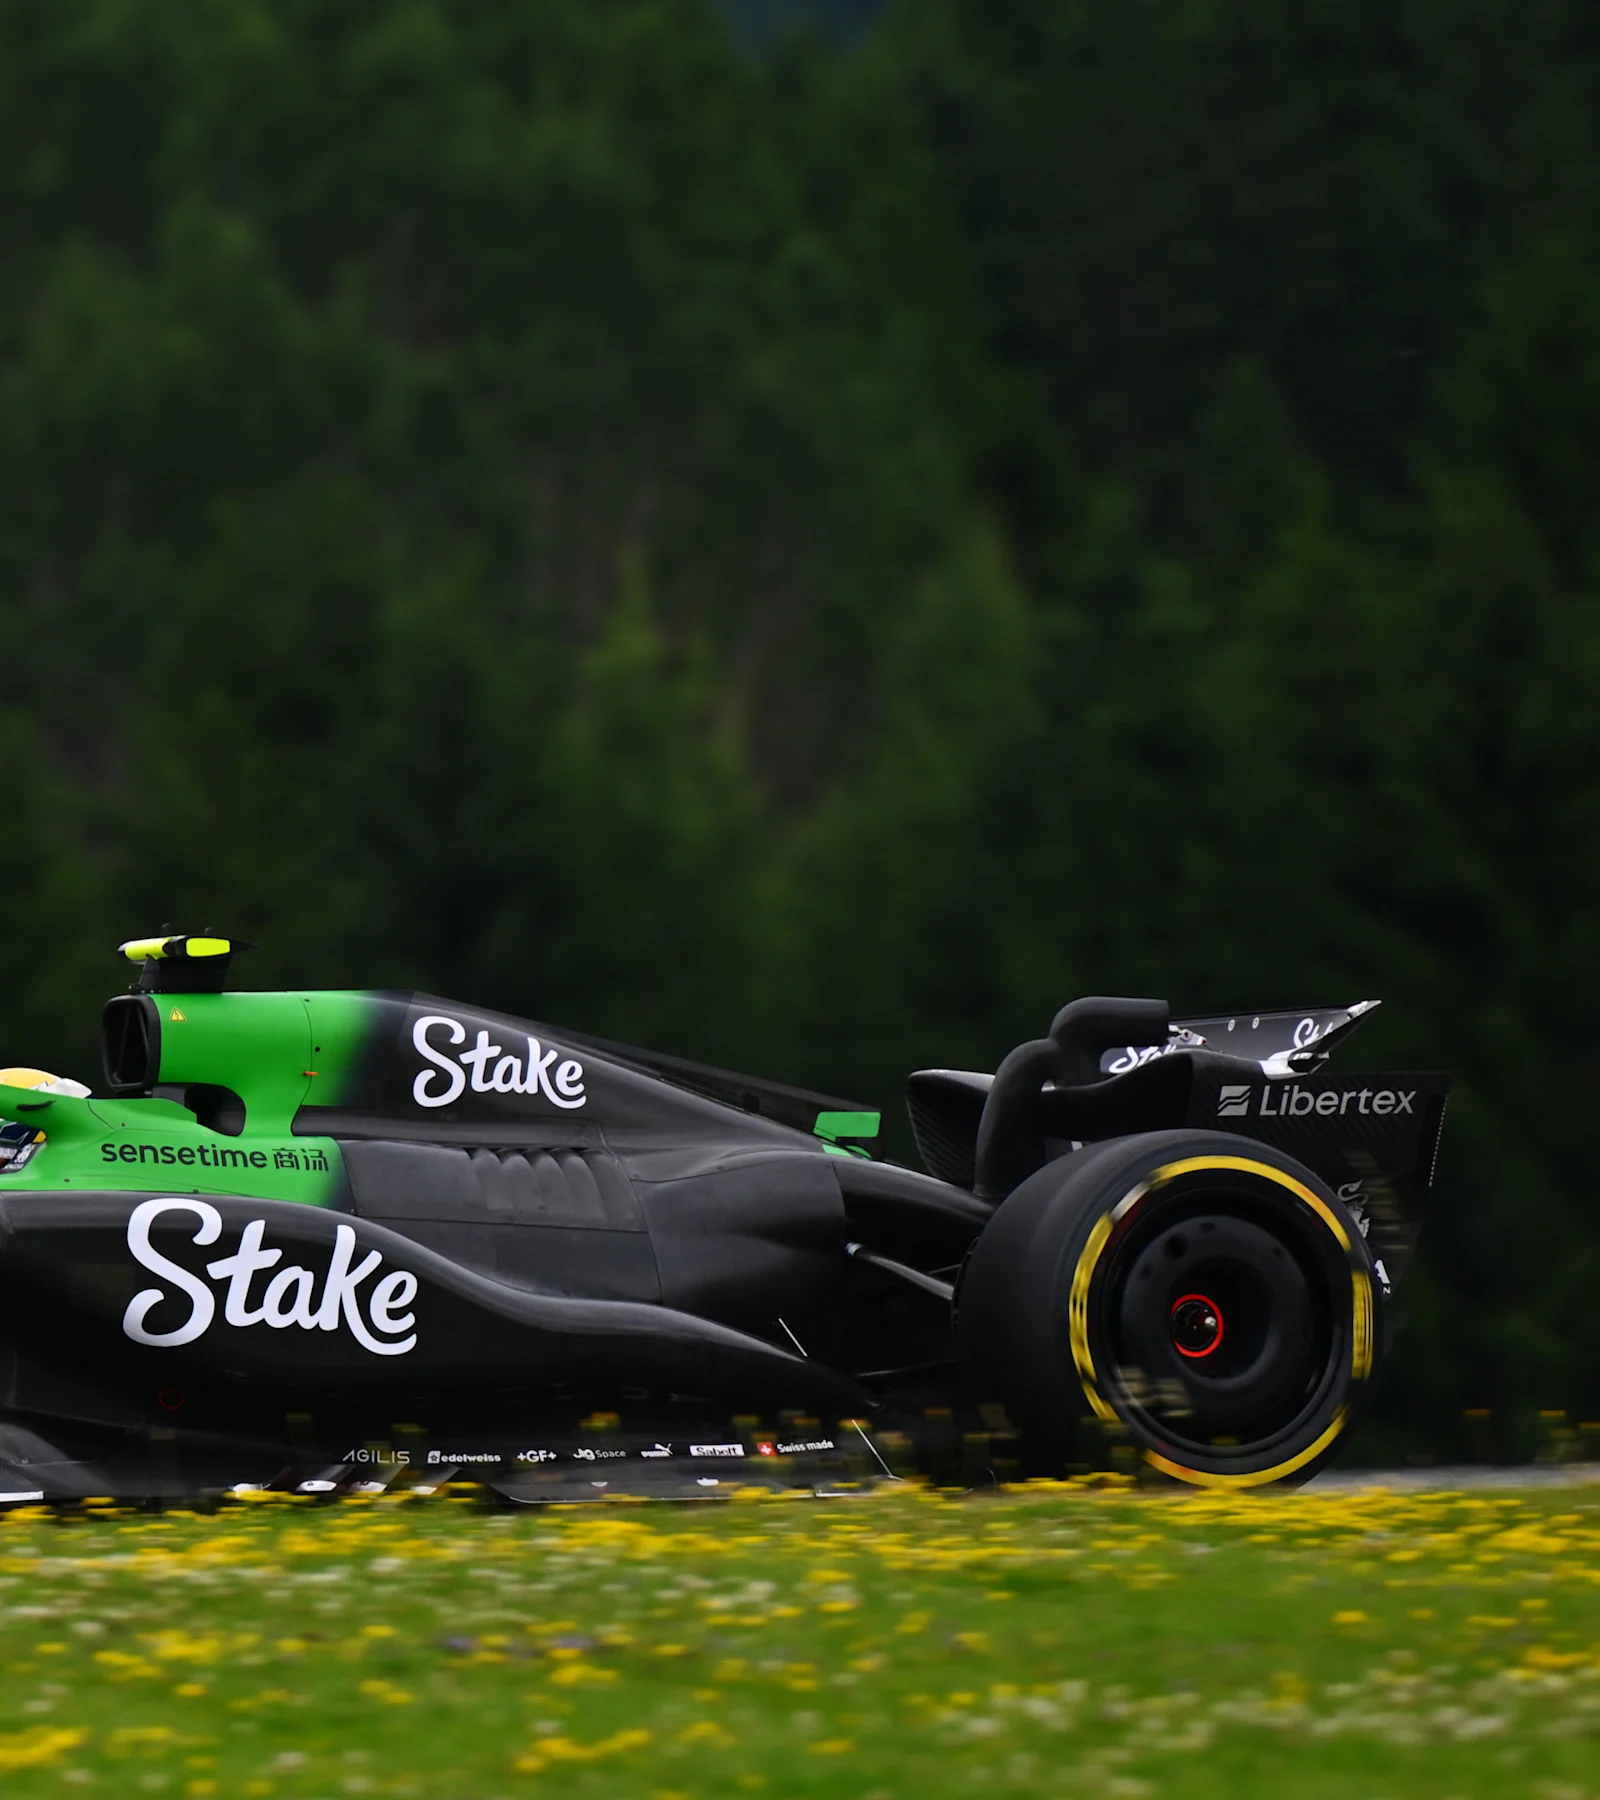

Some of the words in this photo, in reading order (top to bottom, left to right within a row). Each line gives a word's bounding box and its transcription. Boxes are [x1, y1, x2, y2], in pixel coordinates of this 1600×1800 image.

[412, 1015, 587, 1109] Stake
[1259, 1085, 1417, 1116] Libertex
[101, 1143, 269, 1168] sensetime
[273, 1148, 330, 1172] 商汤
[122, 1198, 418, 1356] Stake
[341, 1449, 410, 1464] AGILIS
[440, 1453, 502, 1463] edelweiss
[776, 1442, 806, 1454] Swiss
[806, 1438, 835, 1451] made
